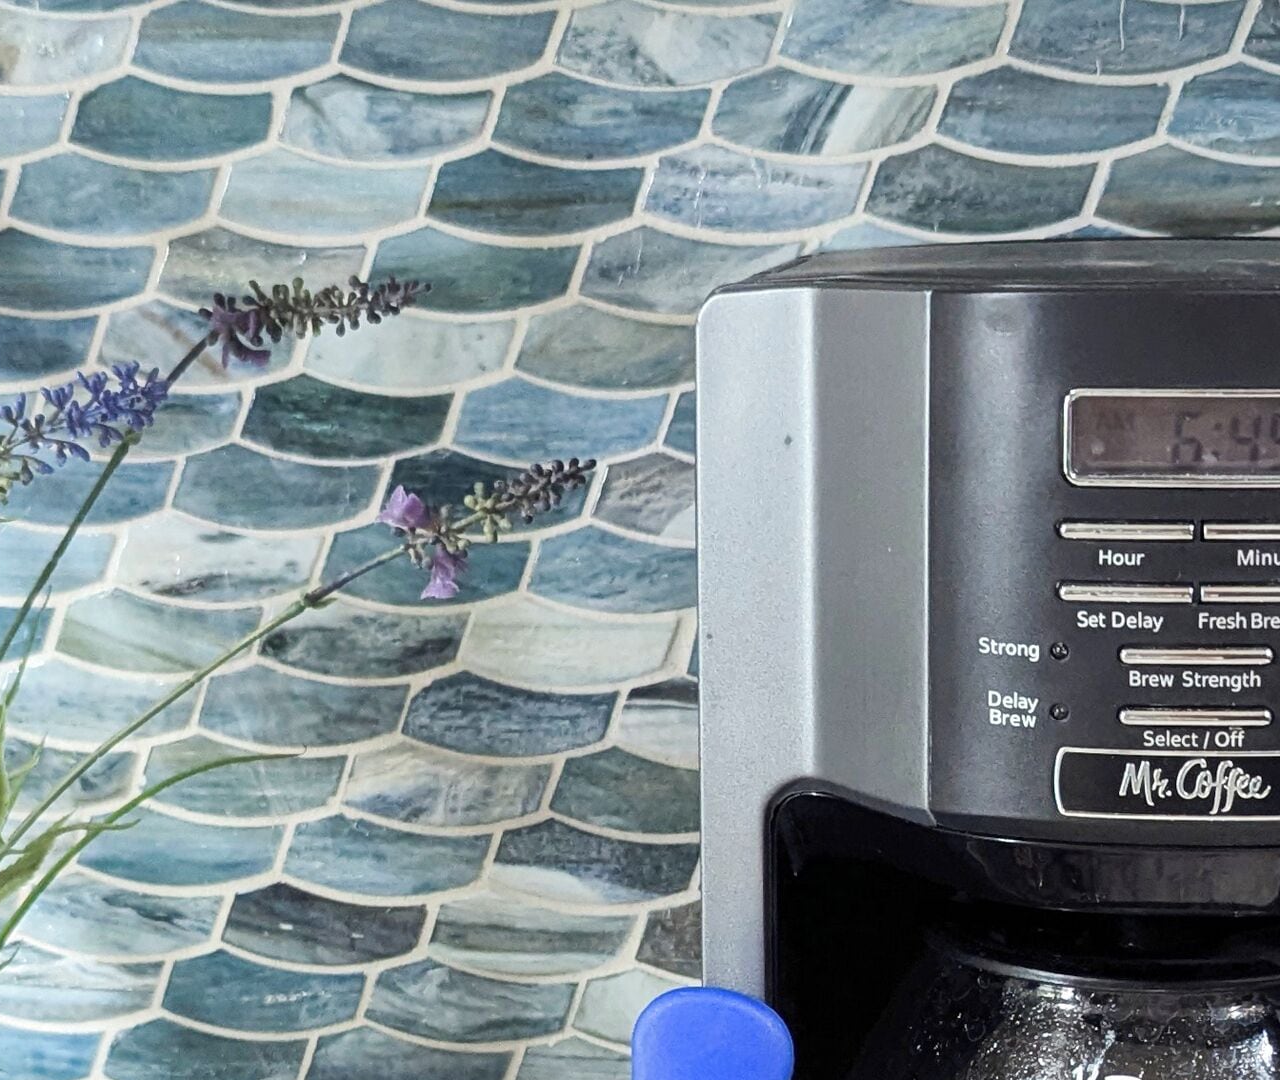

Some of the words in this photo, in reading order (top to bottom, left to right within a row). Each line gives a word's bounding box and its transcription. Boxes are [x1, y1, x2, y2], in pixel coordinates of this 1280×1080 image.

[1098, 549, 1145, 566] Hour
[1076, 610, 1106, 629] Set
[1111, 611, 1164, 633] Delay
[1198, 611, 1247, 629] Fresh
[978, 637, 1040, 662] Strong
[1128, 670, 1174, 687] Brew
[1181, 669, 1262, 692] Strength
[987, 690, 1039, 714] Delay
[989, 709, 1037, 728] Brew
[1143, 730, 1199, 748] Select
[1203, 731, 1210, 750] /
[1214, 730, 1245, 748] Off
[1119, 760, 1173, 806] Mr.
[1176, 758, 1271, 815] Coffee
